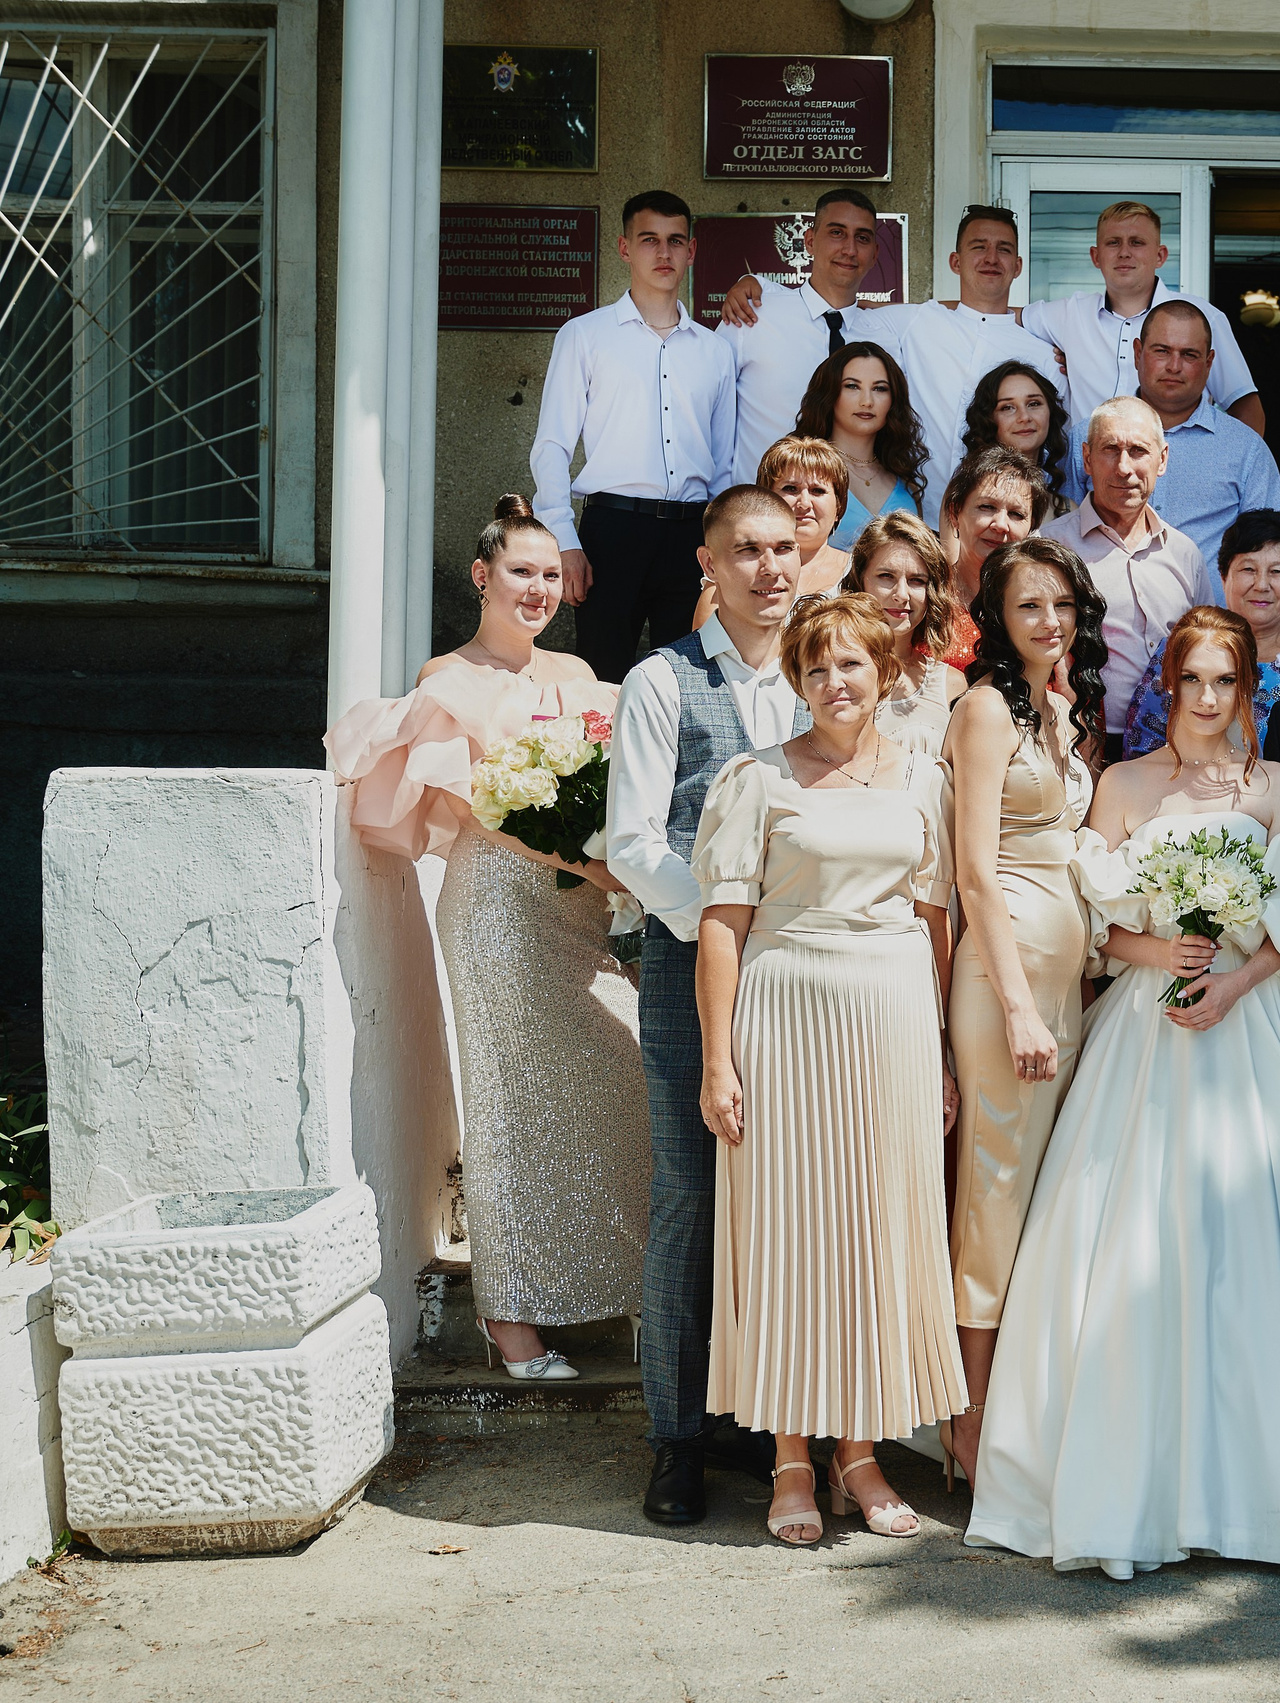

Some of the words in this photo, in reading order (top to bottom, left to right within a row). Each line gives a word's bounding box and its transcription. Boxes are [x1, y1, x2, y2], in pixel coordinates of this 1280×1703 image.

[741, 99, 800, 108] РОССИЙСКАЯ
[803, 101, 856, 110] ФЕДЕРАЦИЯ
[752, 118, 809, 126] ВОРОНЕЖСКОЙ
[742, 133, 804, 141] ГРАЖДАНСКОГО
[807, 133, 854, 141] СОСТОЯНИЯ
[444, 147, 531, 161] ЛЕДСТВЕННЫЙ
[534, 150, 573, 162] ОТДЕЛ
[733, 145, 805, 162] ОТДЕЛ
[811, 145, 863, 161] ЗАГС
[722, 163, 828, 173] ПЕТРОПАВЛОВСКОГО
[831, 164, 873, 174] РАЙОНА
[543, 219, 578, 230] ОРГАН
[440, 232, 518, 245] ФЕДЕРАЛЬНОЙ
[520, 234, 570, 246] СЛУЖБЫ
[522, 250, 592, 262] СТАТИСТИКИ
[446, 264, 528, 277] ВОРОНЕЖСКОЙ
[531, 267, 581, 278] ОБЛАСТИ
[454, 291, 515, 302] СТАТИСТИКИ
[517, 292, 587, 303] ПРЕДПРИЯТИЙ
[440, 305, 533, 316] ПЕТРОПАВЛОВСКИЙ
[535, 306, 572, 318] РАЙОН)
